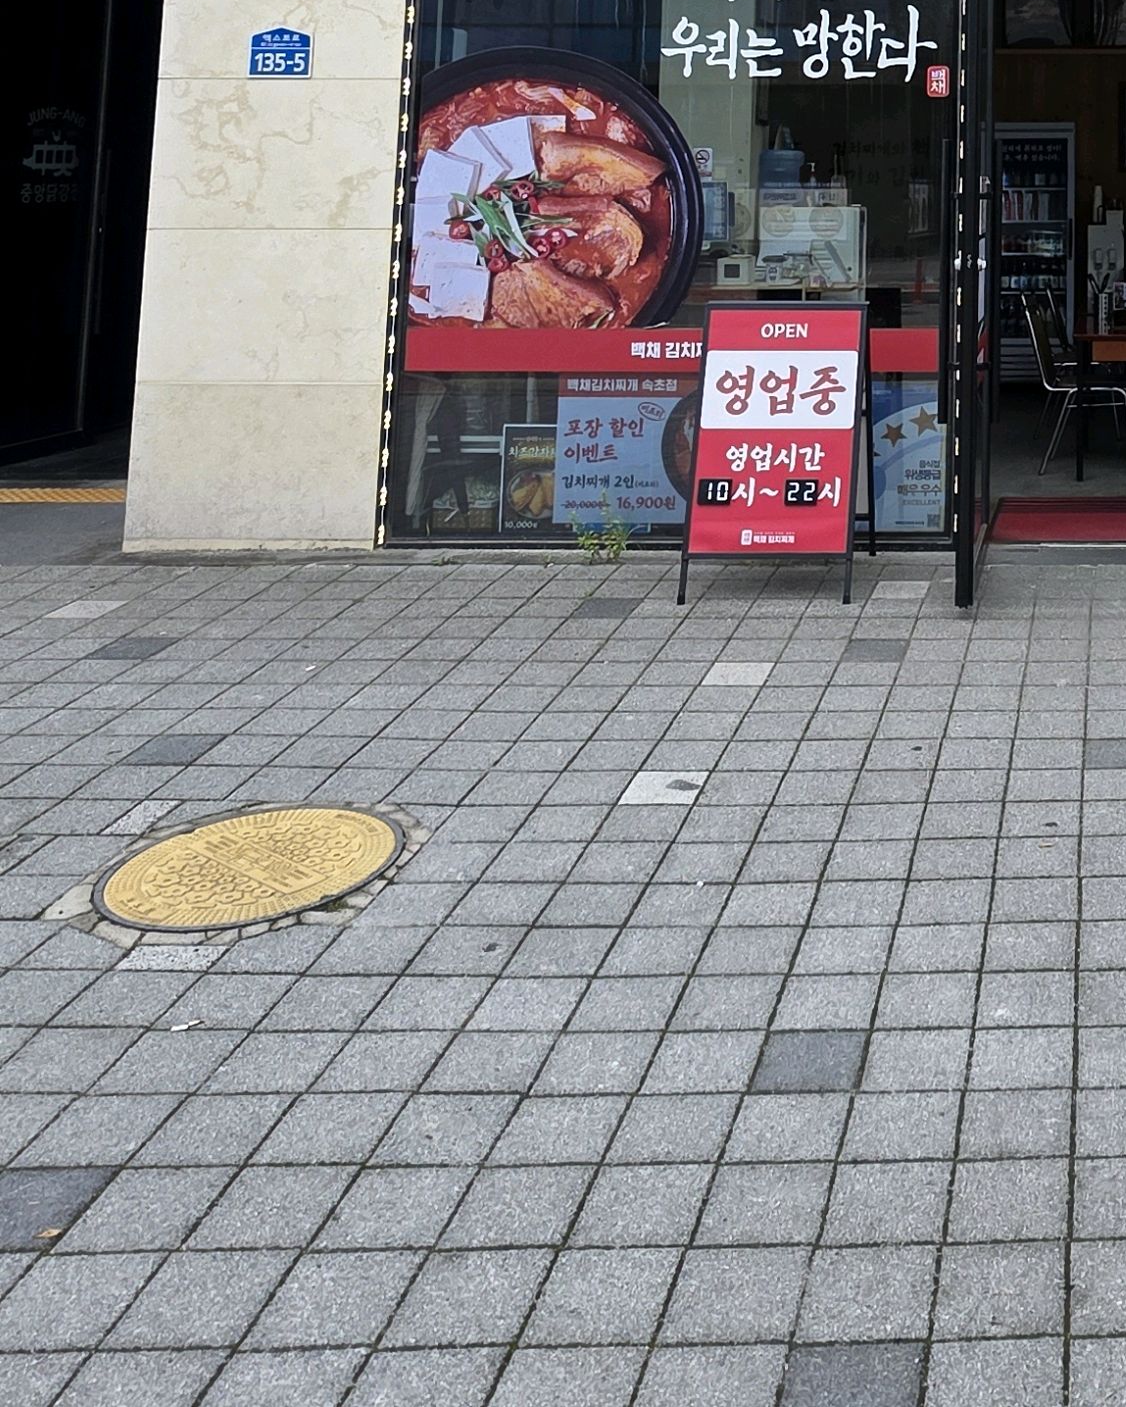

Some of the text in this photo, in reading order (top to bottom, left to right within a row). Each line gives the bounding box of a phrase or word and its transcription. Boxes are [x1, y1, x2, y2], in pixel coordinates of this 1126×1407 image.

[660, 5, 937, 82] 우리는 망한다
[254, 53, 306, 72] 135-5
[760, 323, 808, 340] OPEN
[631, 341, 661, 359] 백채
[567, 379, 677, 392] 백채김치찌개 속초점
[716, 366, 847, 417] 영업중
[563, 417, 645, 439] 포장 할인
[563, 443, 619, 464] 이벤트
[726, 442, 825, 474] 영업시간
[562, 474, 610, 490] 김치찌개
[616, 495, 677, 511] 16,900원
